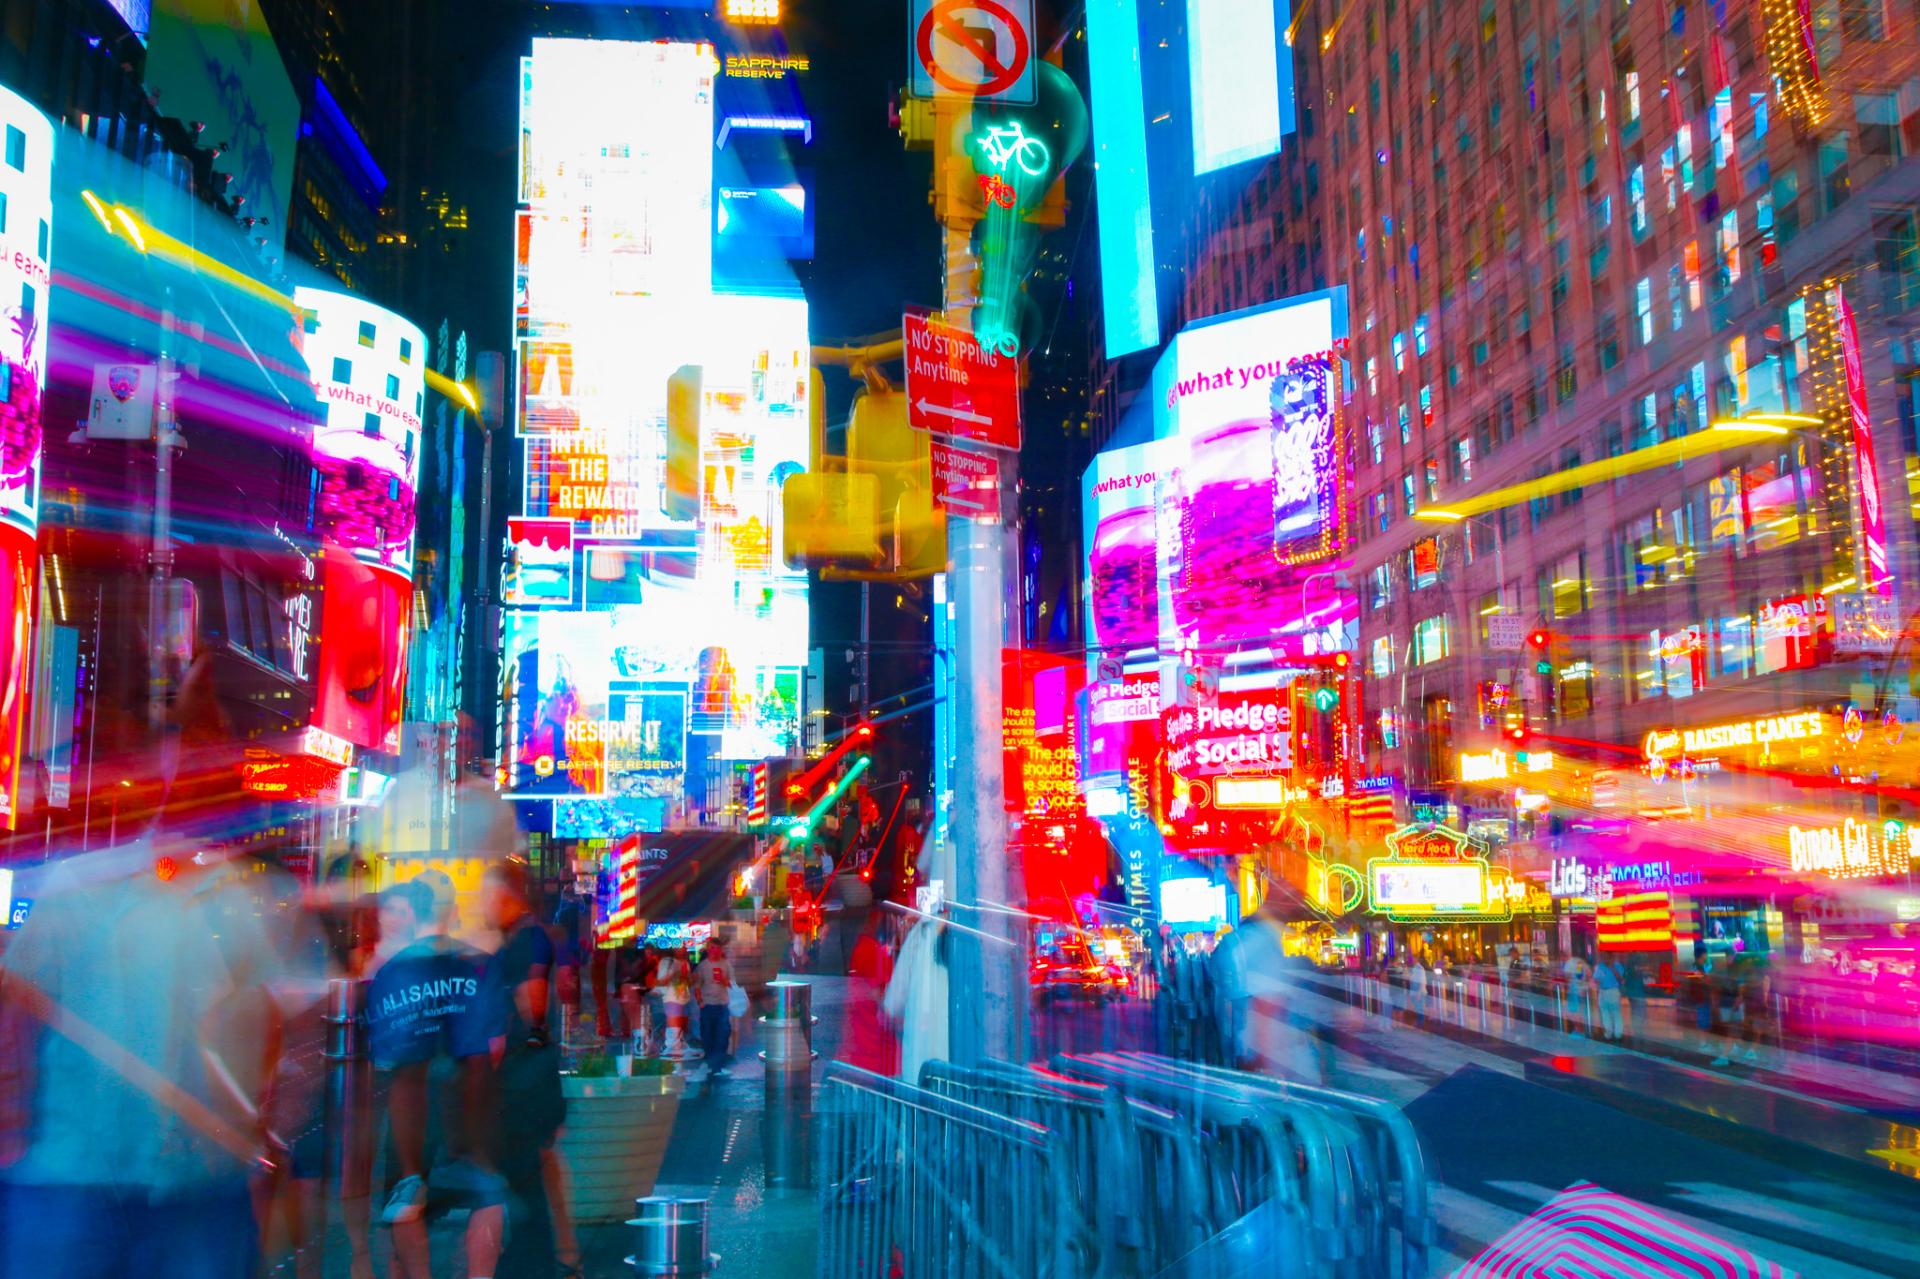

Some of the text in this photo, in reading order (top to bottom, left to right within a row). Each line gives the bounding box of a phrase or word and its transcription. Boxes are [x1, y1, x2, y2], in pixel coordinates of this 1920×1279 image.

[726, 57, 810, 71] SAPPHIRE
[911, 328, 998, 369] NO STOPPING
[914, 355, 969, 386] Anytime
[1177, 367, 1234, 398] what
[1239, 360, 1281, 389] you
[328, 386, 373, 408] what
[376, 399, 401, 419] you
[568, 458, 605, 482] THE
[933, 450, 988, 475] NO STOPPING
[935, 465, 969, 487] Anytime
[1098, 473, 1132, 495] what
[1110, 679, 1159, 698] Pledge
[1005, 708, 1021, 717] The
[1109, 700, 1153, 717] Social
[1199, 700, 1279, 731] Pledge
[565, 720, 642, 742] RESERVE
[1027, 746, 1052, 760] The
[1195, 732, 1269, 765] Social
[1128, 757, 1141, 830] SQUARE
[1426, 842, 1450, 855] Rock
[1130, 850, 1143, 907] TIMES
[1551, 856, 1586, 897] Lids
[1611, 864, 1641, 882] TACO
